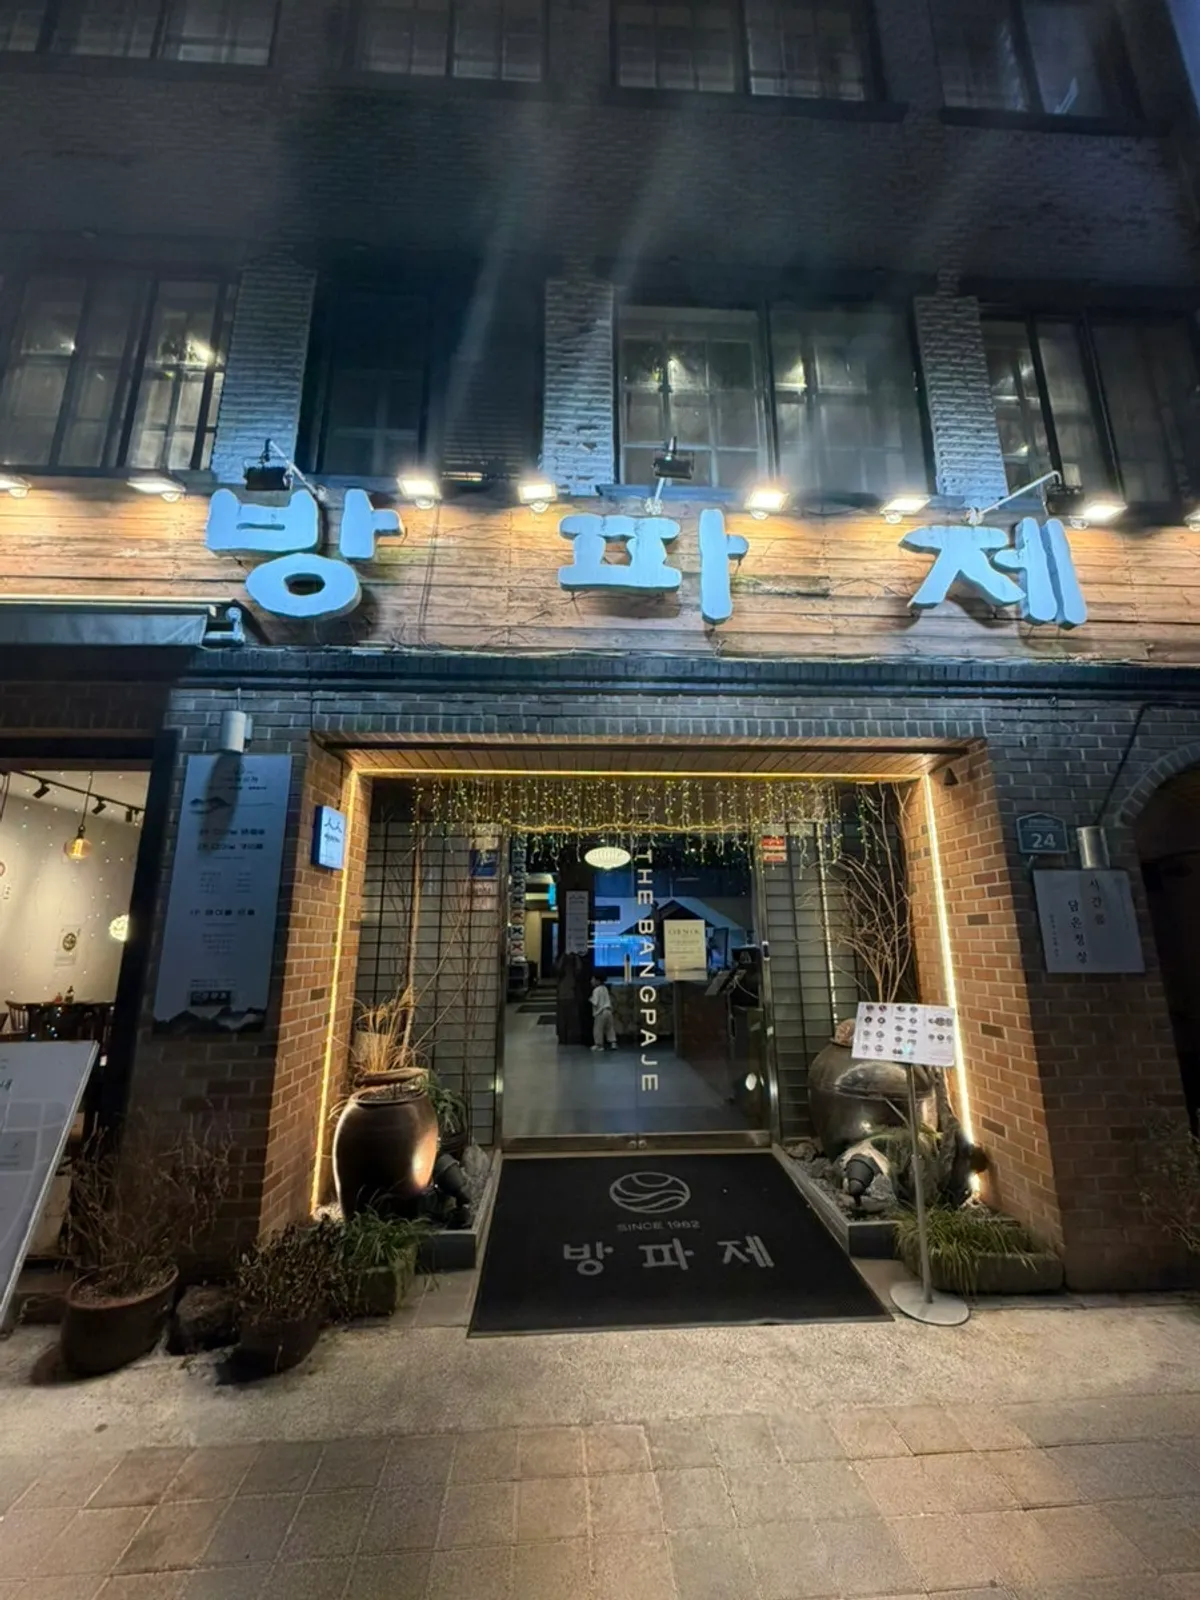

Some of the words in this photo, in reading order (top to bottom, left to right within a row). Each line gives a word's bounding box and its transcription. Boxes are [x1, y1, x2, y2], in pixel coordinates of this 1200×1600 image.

[206, 488, 1087, 630] 방파제
[1031, 832, 1057, 849] 24
[635, 849, 654, 906] THE
[637, 919, 659, 1092] BANGPAJE
[616, 1221, 663, 1233] SINCE
[562, 1235, 775, 1276] 방파제
